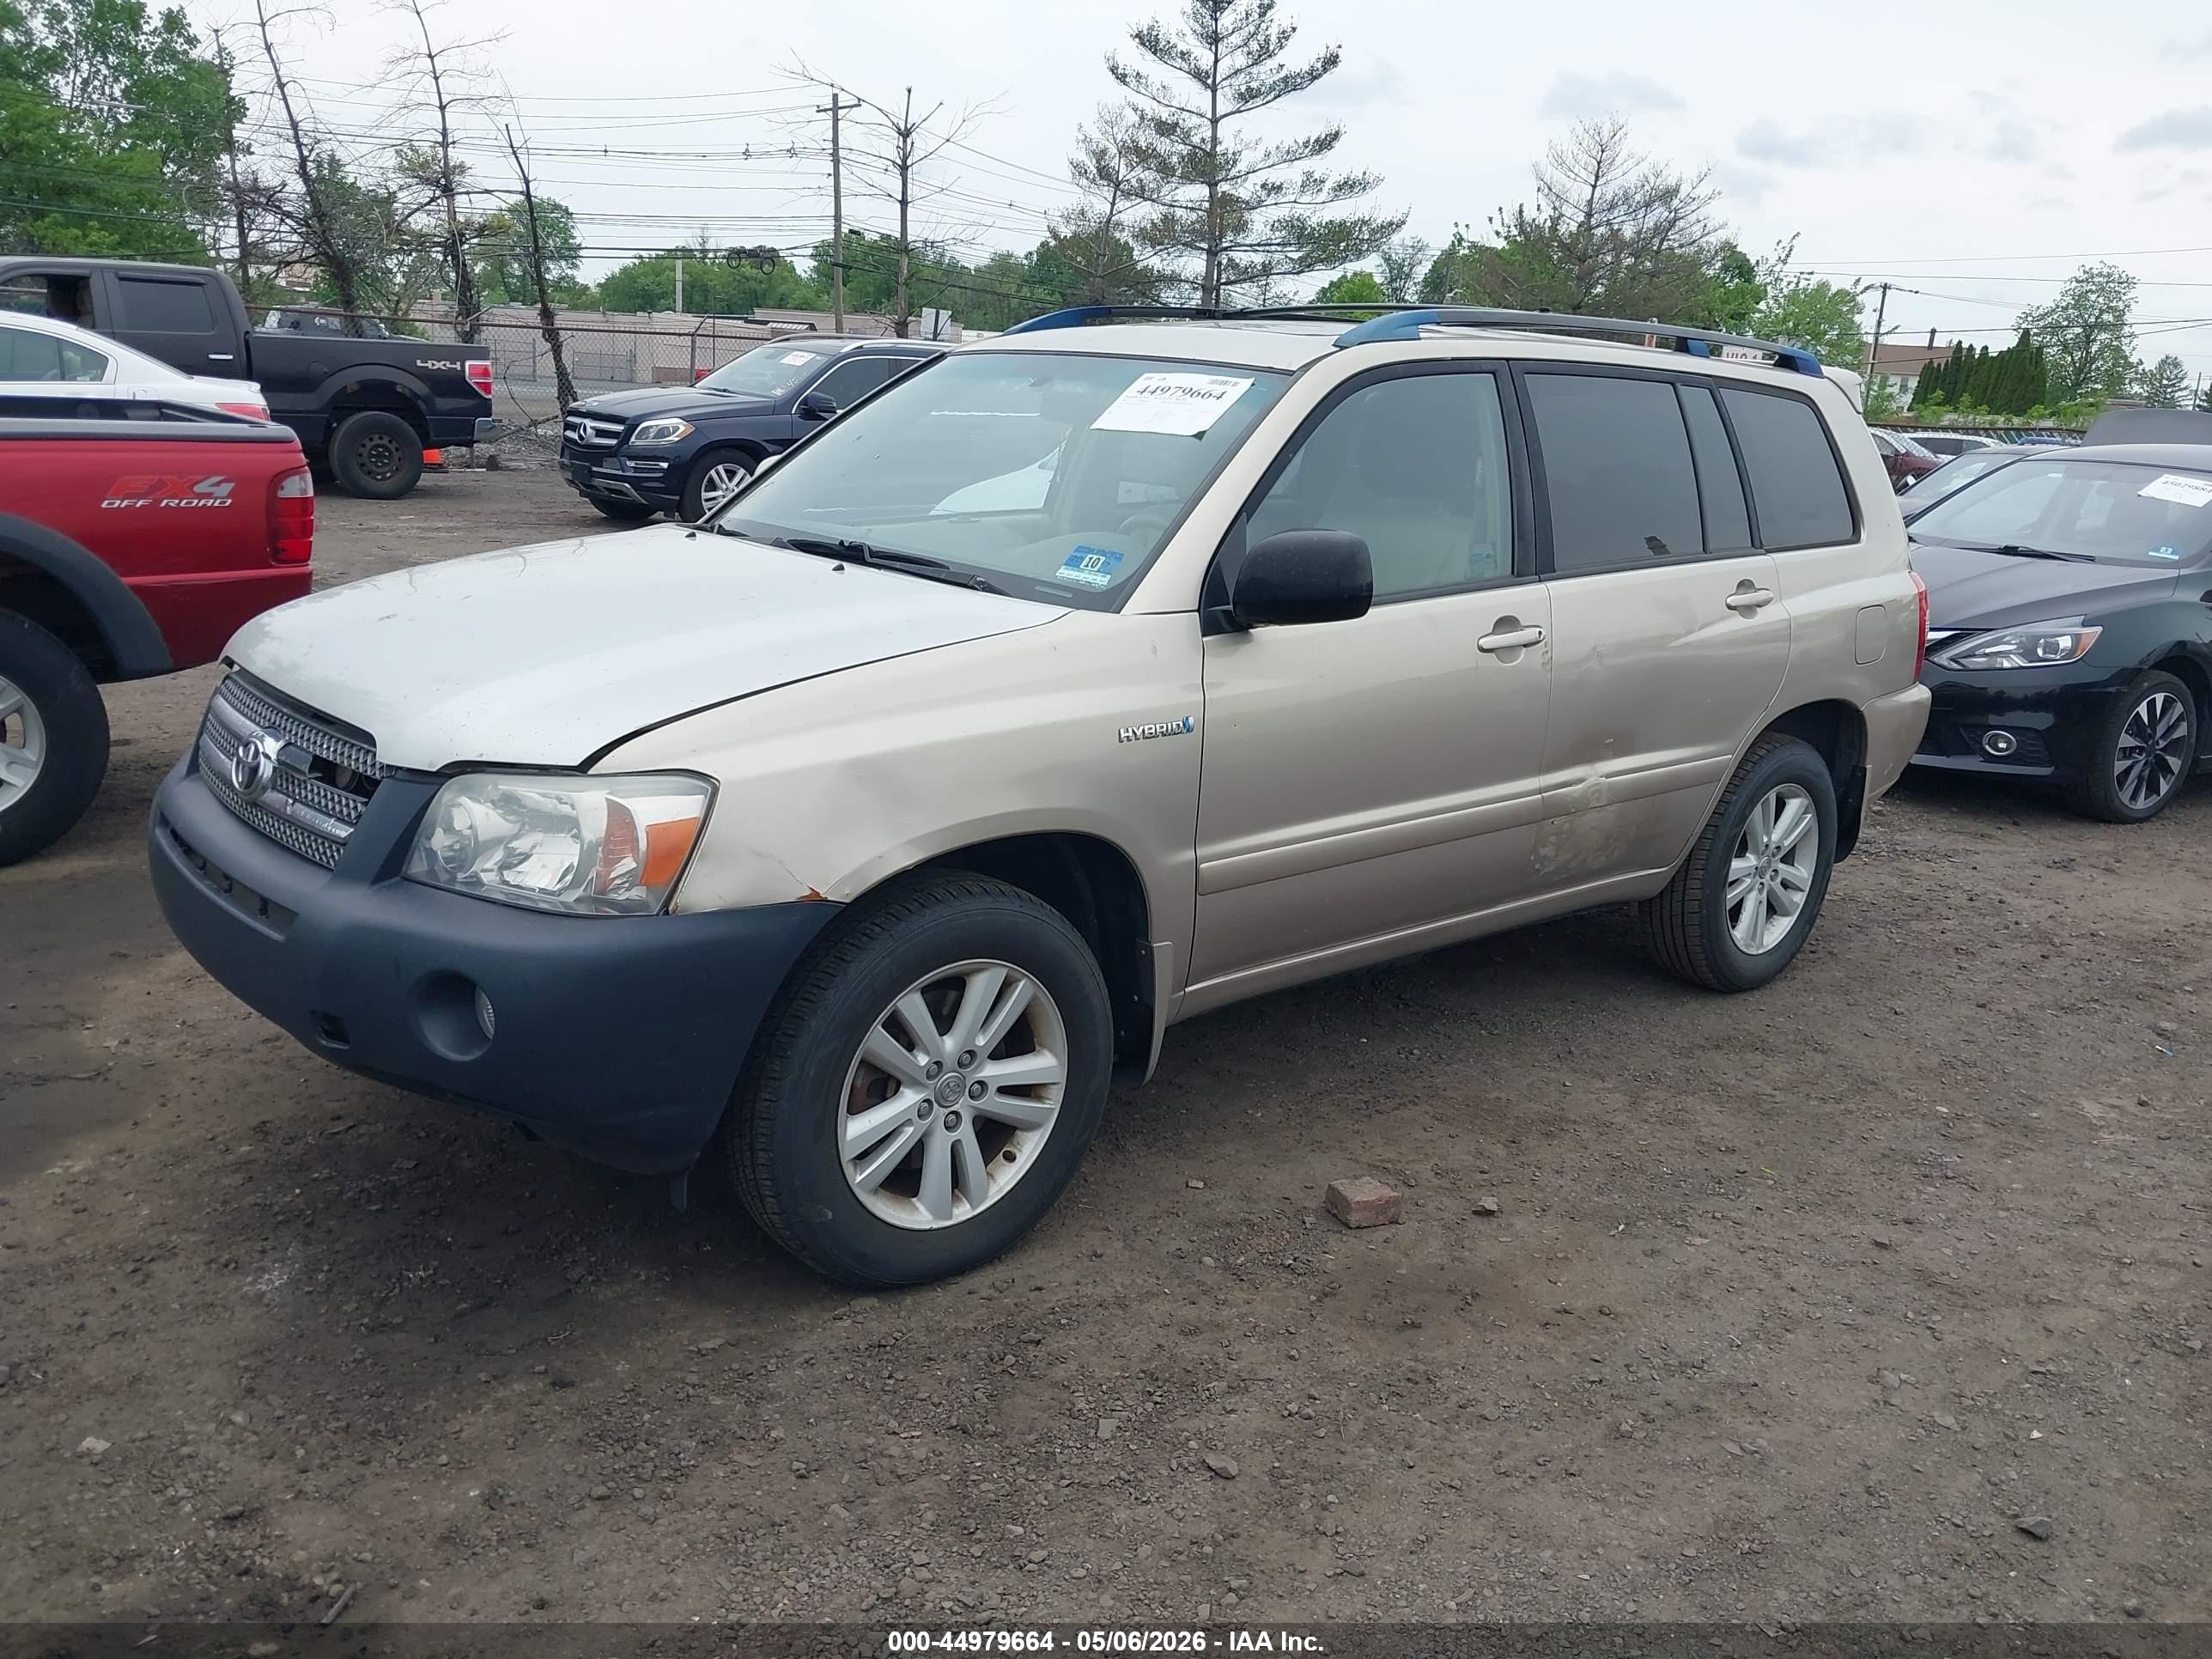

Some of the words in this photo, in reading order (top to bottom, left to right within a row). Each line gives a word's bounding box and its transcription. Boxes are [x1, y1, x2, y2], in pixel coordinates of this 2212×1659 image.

[416, 360, 461, 370] 4X4
[1136, 385, 1228, 401] 44979664
[107, 475, 235, 498] FX4
[101, 499, 153, 508] OFF
[160, 499, 233, 507] ROAD
[1083, 556, 1102, 568] 10
[1119, 720, 1184, 743] HYBRID
